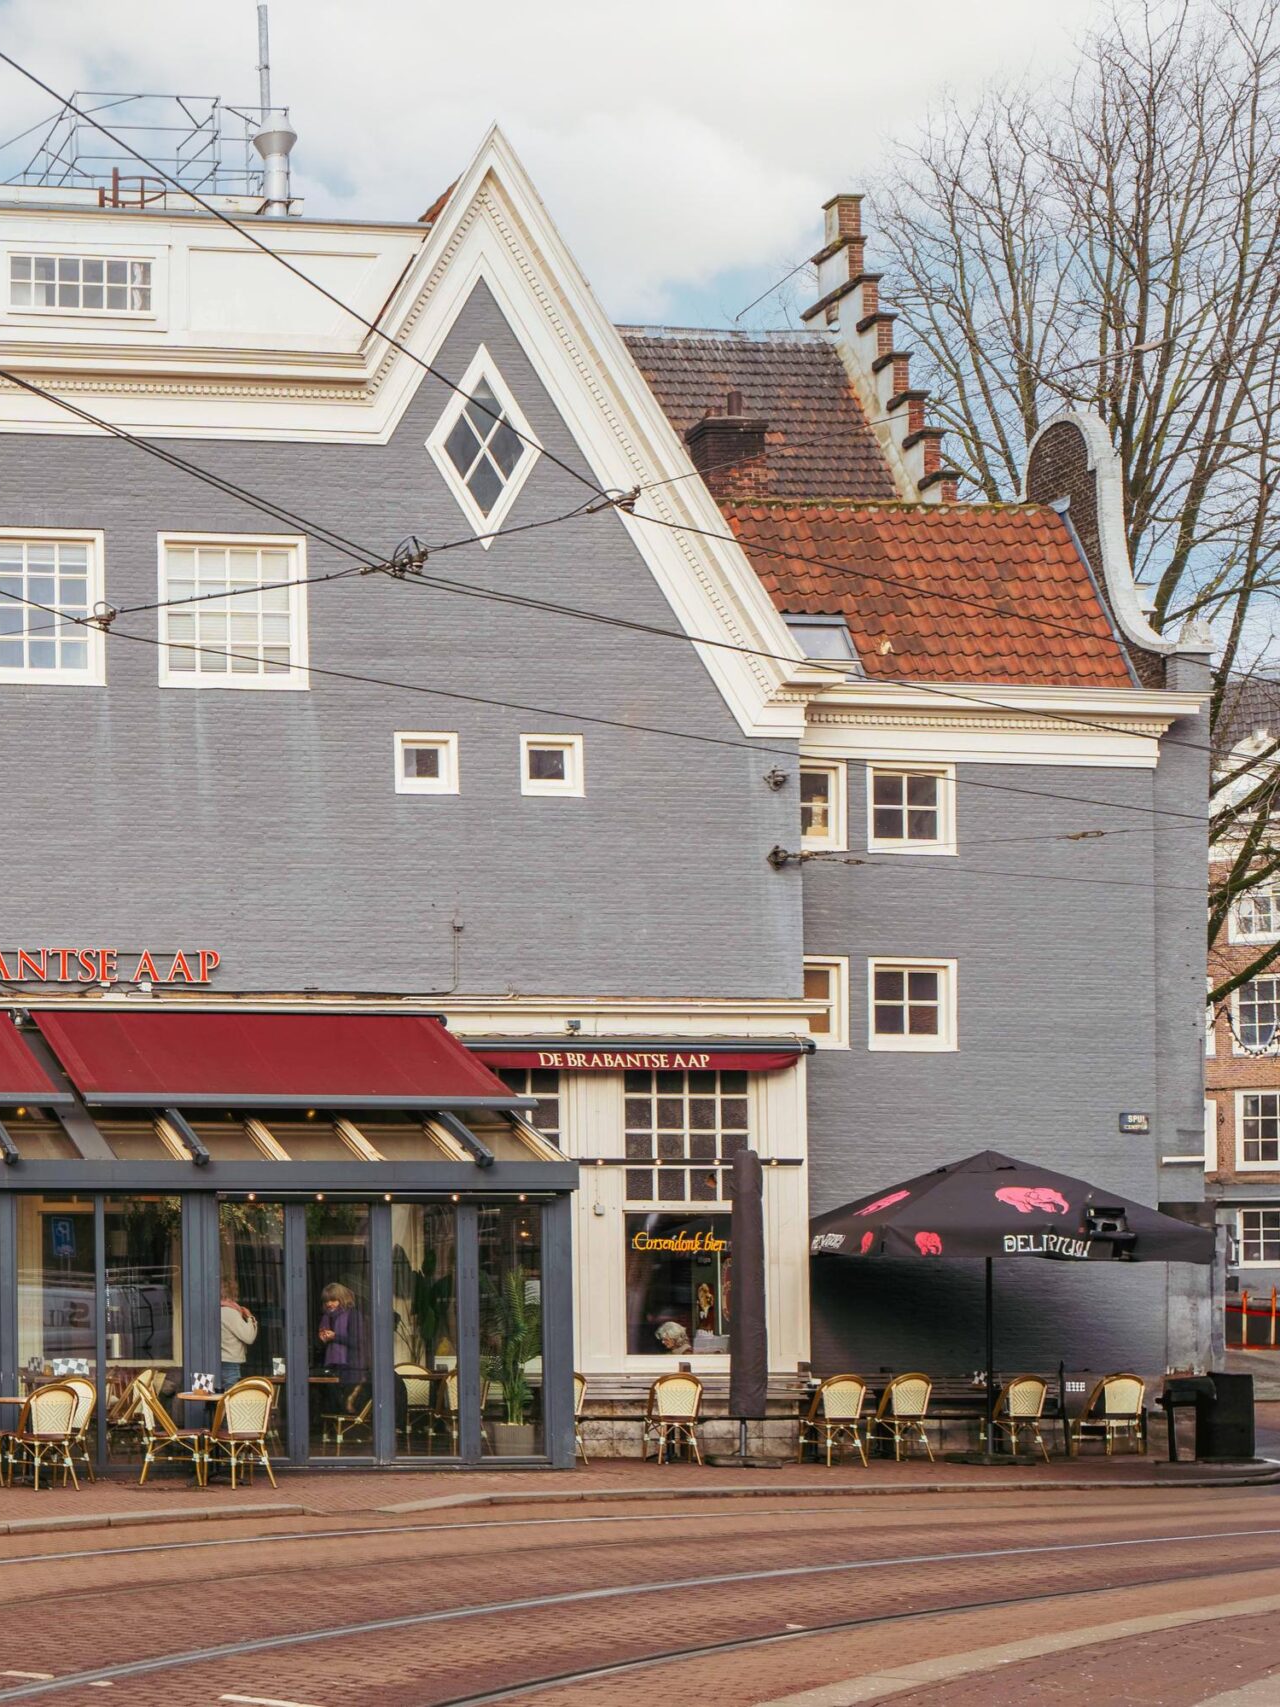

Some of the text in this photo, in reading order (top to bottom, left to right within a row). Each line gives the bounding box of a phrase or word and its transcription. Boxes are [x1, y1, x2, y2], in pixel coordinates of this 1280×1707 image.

[132, 948, 221, 985] AAP
[538, 1052, 710, 1069] DE BRABANTSE AAP
[1127, 1114, 1145, 1123] SPUI
[634, 1231, 723, 1252] Corsendonk bier
